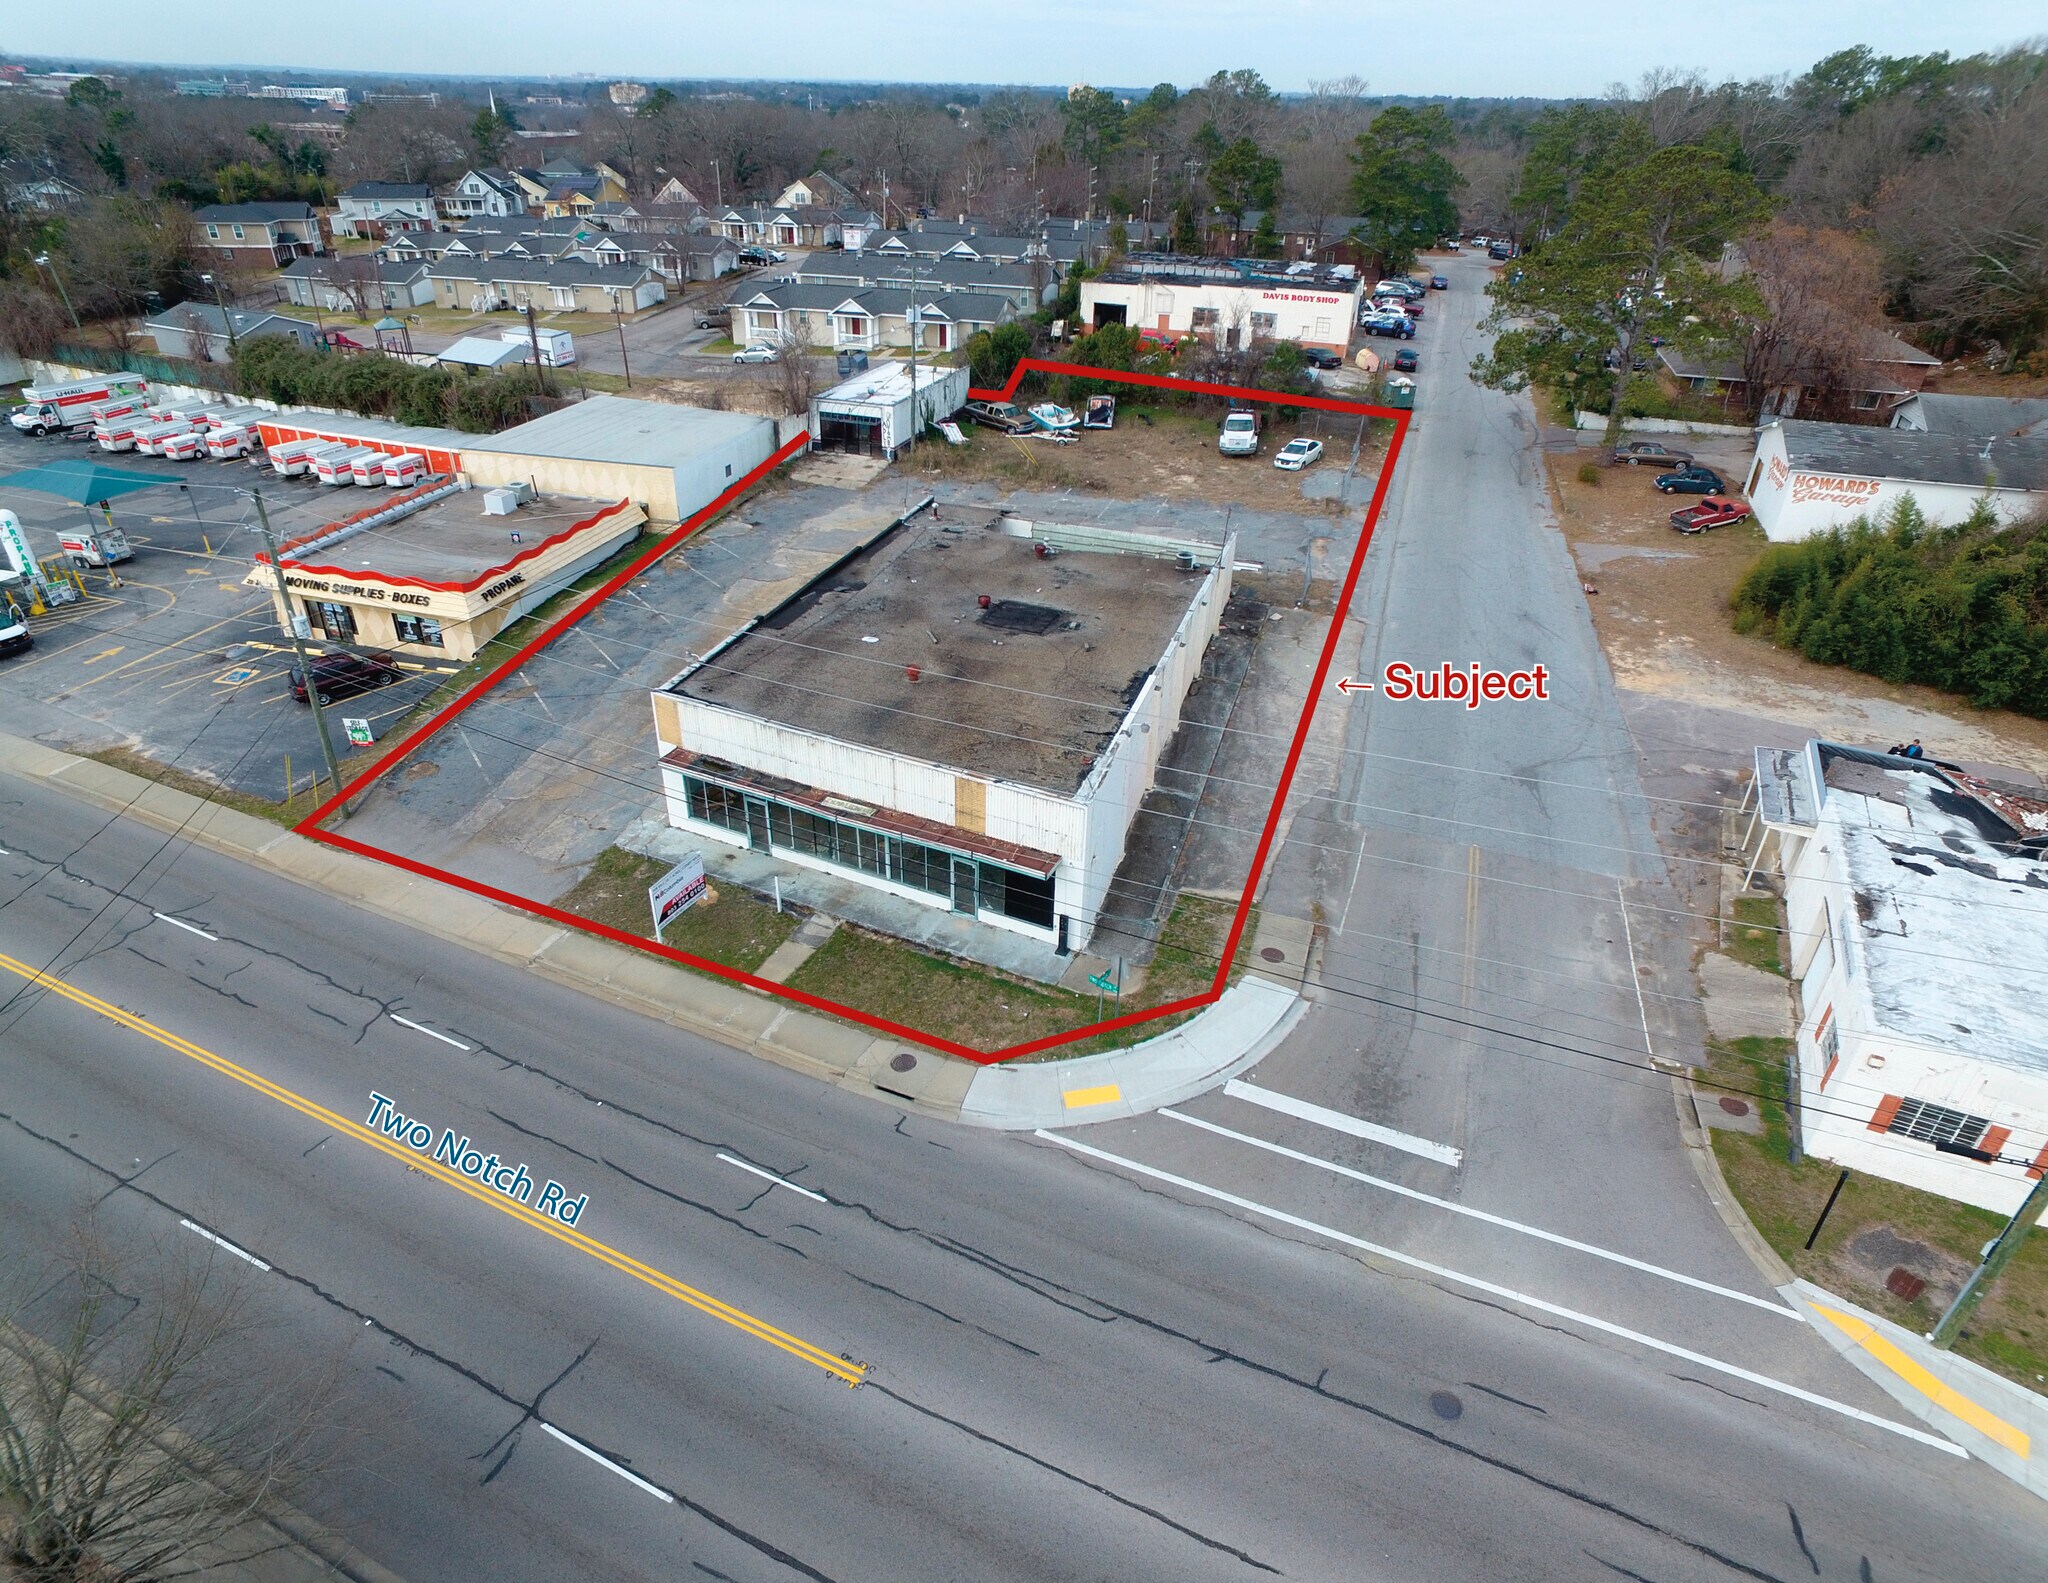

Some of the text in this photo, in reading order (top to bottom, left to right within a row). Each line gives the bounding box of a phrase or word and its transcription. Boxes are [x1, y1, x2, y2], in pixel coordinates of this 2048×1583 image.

[1262, 292, 1340, 304] DAVIS BODY SHOP
[1793, 475, 1882, 495] HOWARD'S
[1792, 486, 1870, 508] Garage
[285, 576, 330, 592] MOVING
[332, 583, 385, 600] SUPPLIES
[392, 591, 431, 607] BOXES
[481, 572, 526, 602] PROPANE
[671, 876, 705, 904] AVAILABLE
[689, 883, 705, 897] 0100
